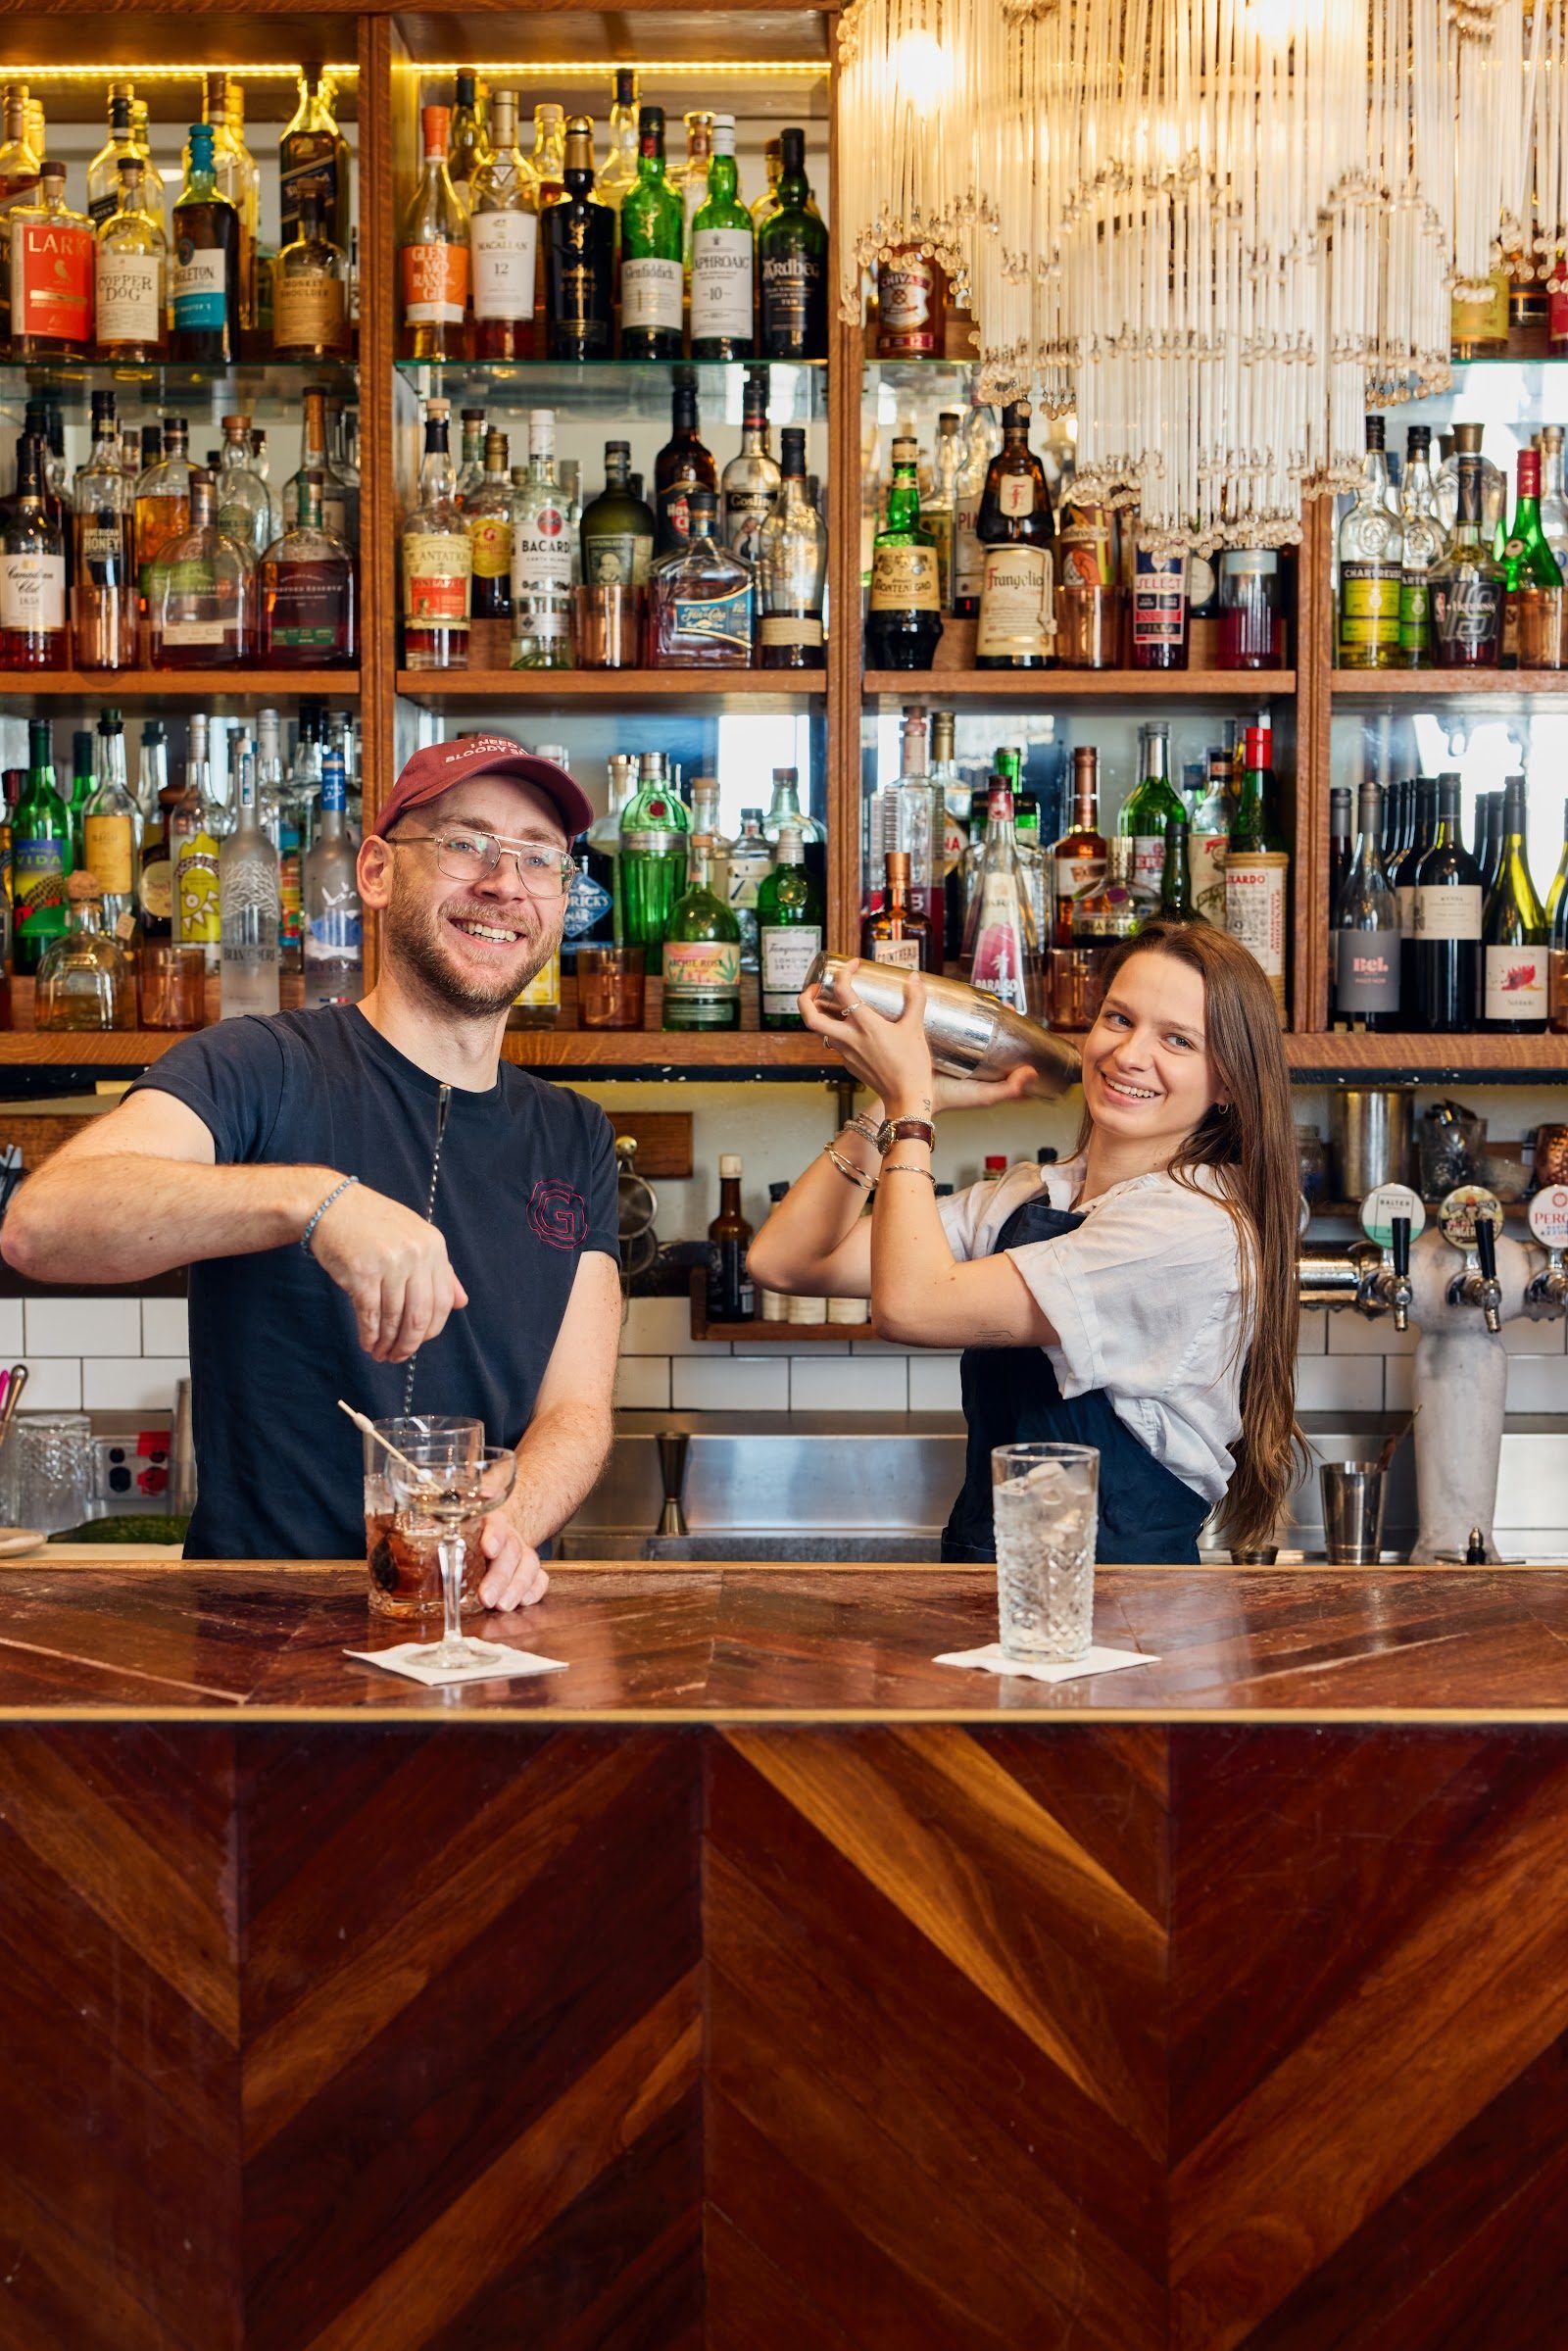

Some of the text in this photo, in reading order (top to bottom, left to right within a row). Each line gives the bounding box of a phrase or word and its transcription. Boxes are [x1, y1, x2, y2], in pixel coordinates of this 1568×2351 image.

[28, 231, 87, 255] LARK
[494, 263, 509, 274] 12
[99, 274, 152, 291] COPPER
[106, 287, 141, 302] DOG
[710, 286, 722, 300] 10
[84, 538, 120, 551] HONEY
[478, 738, 518, 749] NEED
[445, 745, 508, 763] BLOODY
[17, 856, 61, 864] VIDA
